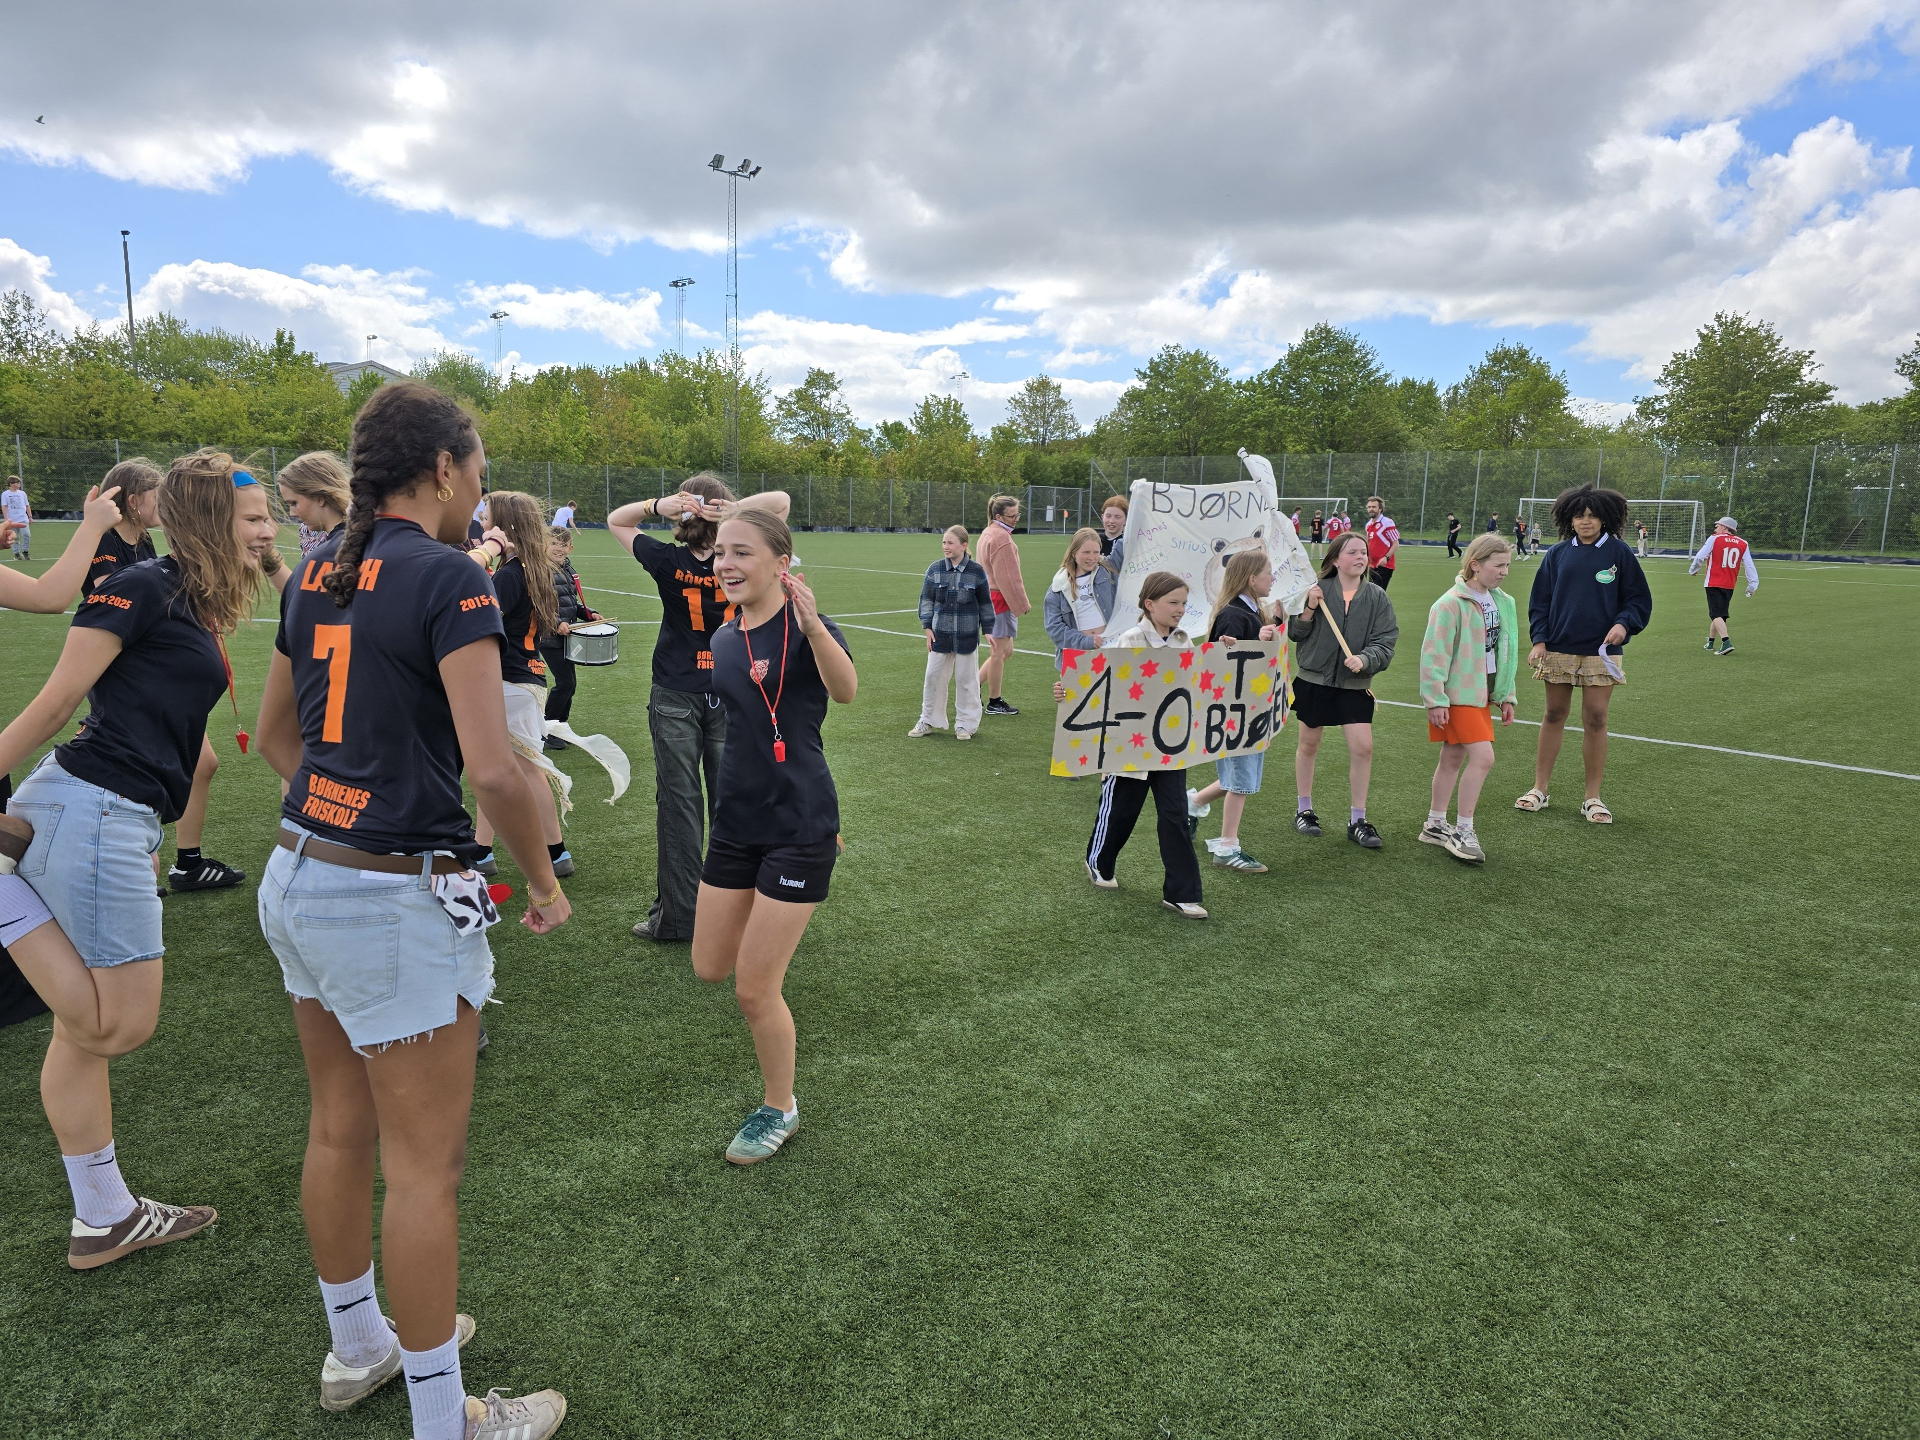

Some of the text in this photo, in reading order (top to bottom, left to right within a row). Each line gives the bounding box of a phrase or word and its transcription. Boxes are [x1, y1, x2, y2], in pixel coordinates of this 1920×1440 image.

[1137, 522, 1167, 541] Agnes
[1332, 522, 1339, 531] 9
[1171, 538, 1207, 554] Sirius
[1722, 547, 1740, 569] 10
[300, 558, 384, 592] LAH
[697, 660, 715, 669] FRIS
[313, 624, 352, 743] 7
[308, 773, 372, 810] BØRNENES
[301, 795, 360, 830] FRISKOLE
